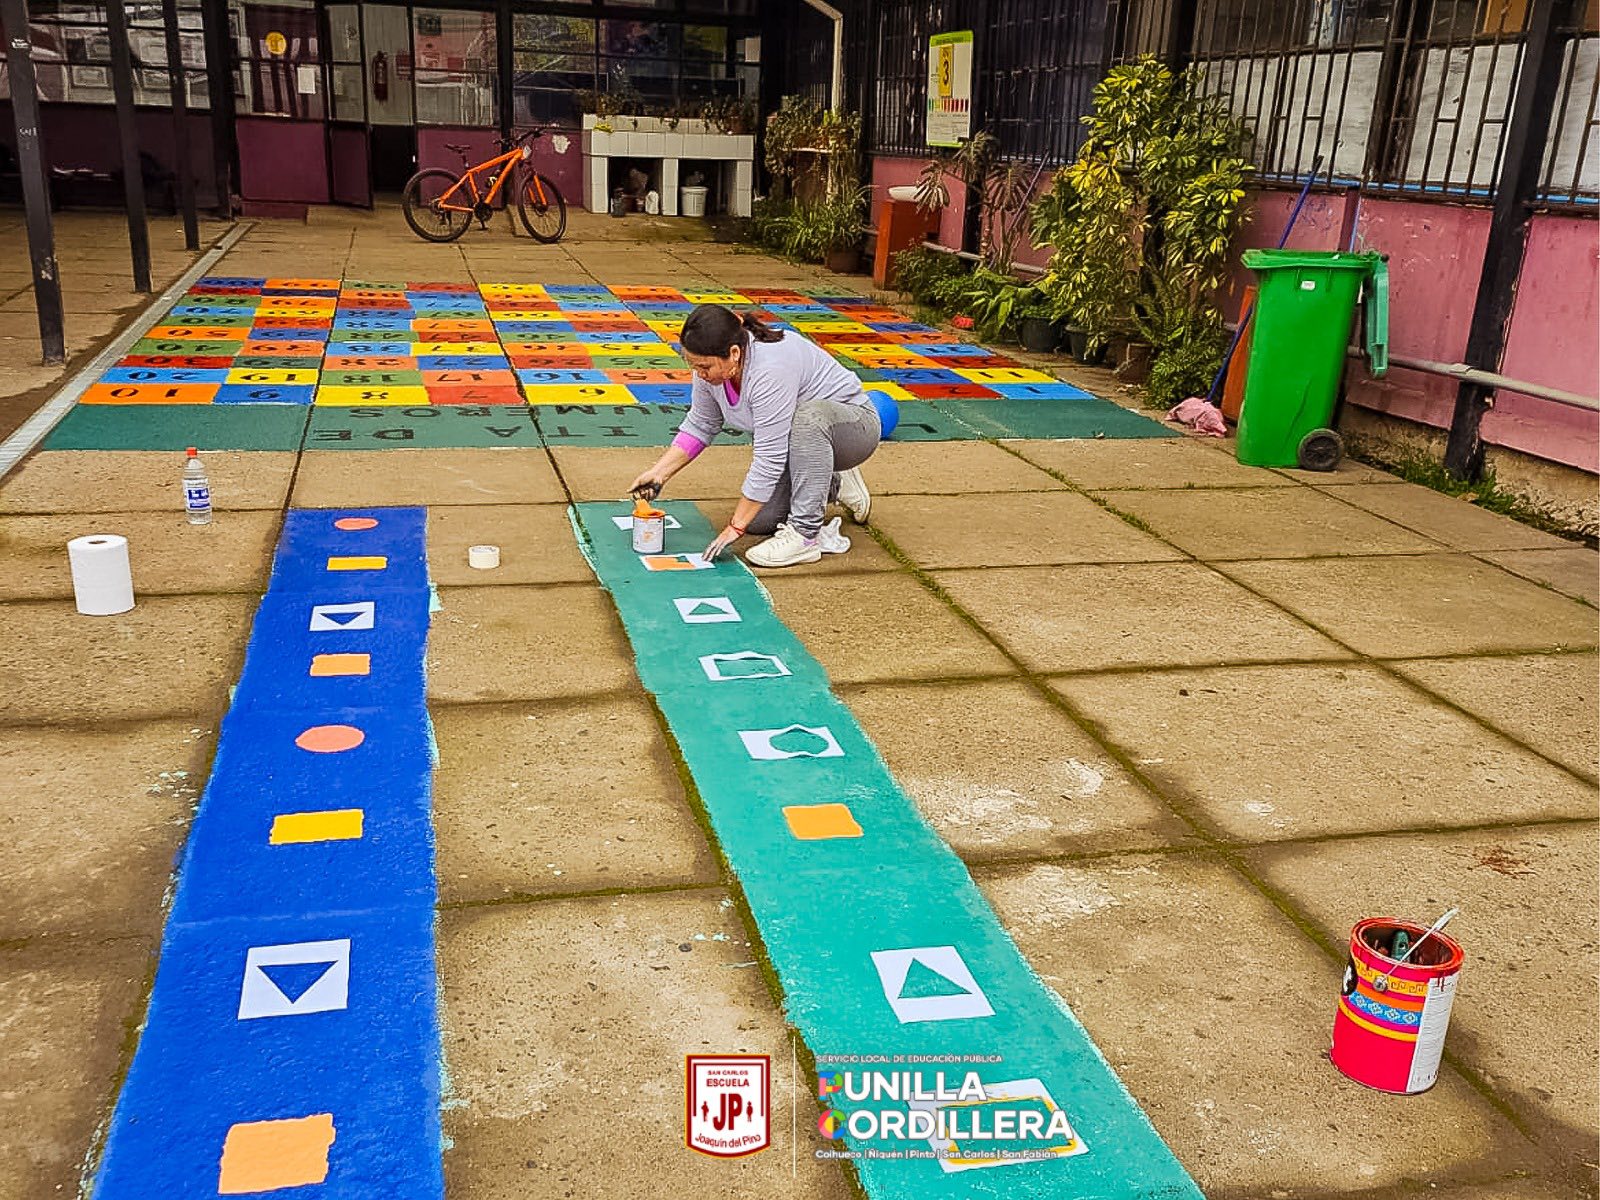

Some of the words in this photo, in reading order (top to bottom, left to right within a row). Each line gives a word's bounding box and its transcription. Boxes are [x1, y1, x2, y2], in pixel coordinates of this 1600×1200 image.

[143, 357, 209, 365] 30
[127, 372, 199, 380] 20
[239, 373, 300, 381] 19
[344, 374, 396, 383] 18
[534, 373, 589, 381] 16
[109, 388, 181, 398] 10
[249, 389, 280, 399] 9
[361, 391, 388, 400] 8
[462, 390, 488, 399] 7
[579, 388, 605, 397] 6
[660, 389, 685, 397] 5
[312, 429, 414, 440] DE
